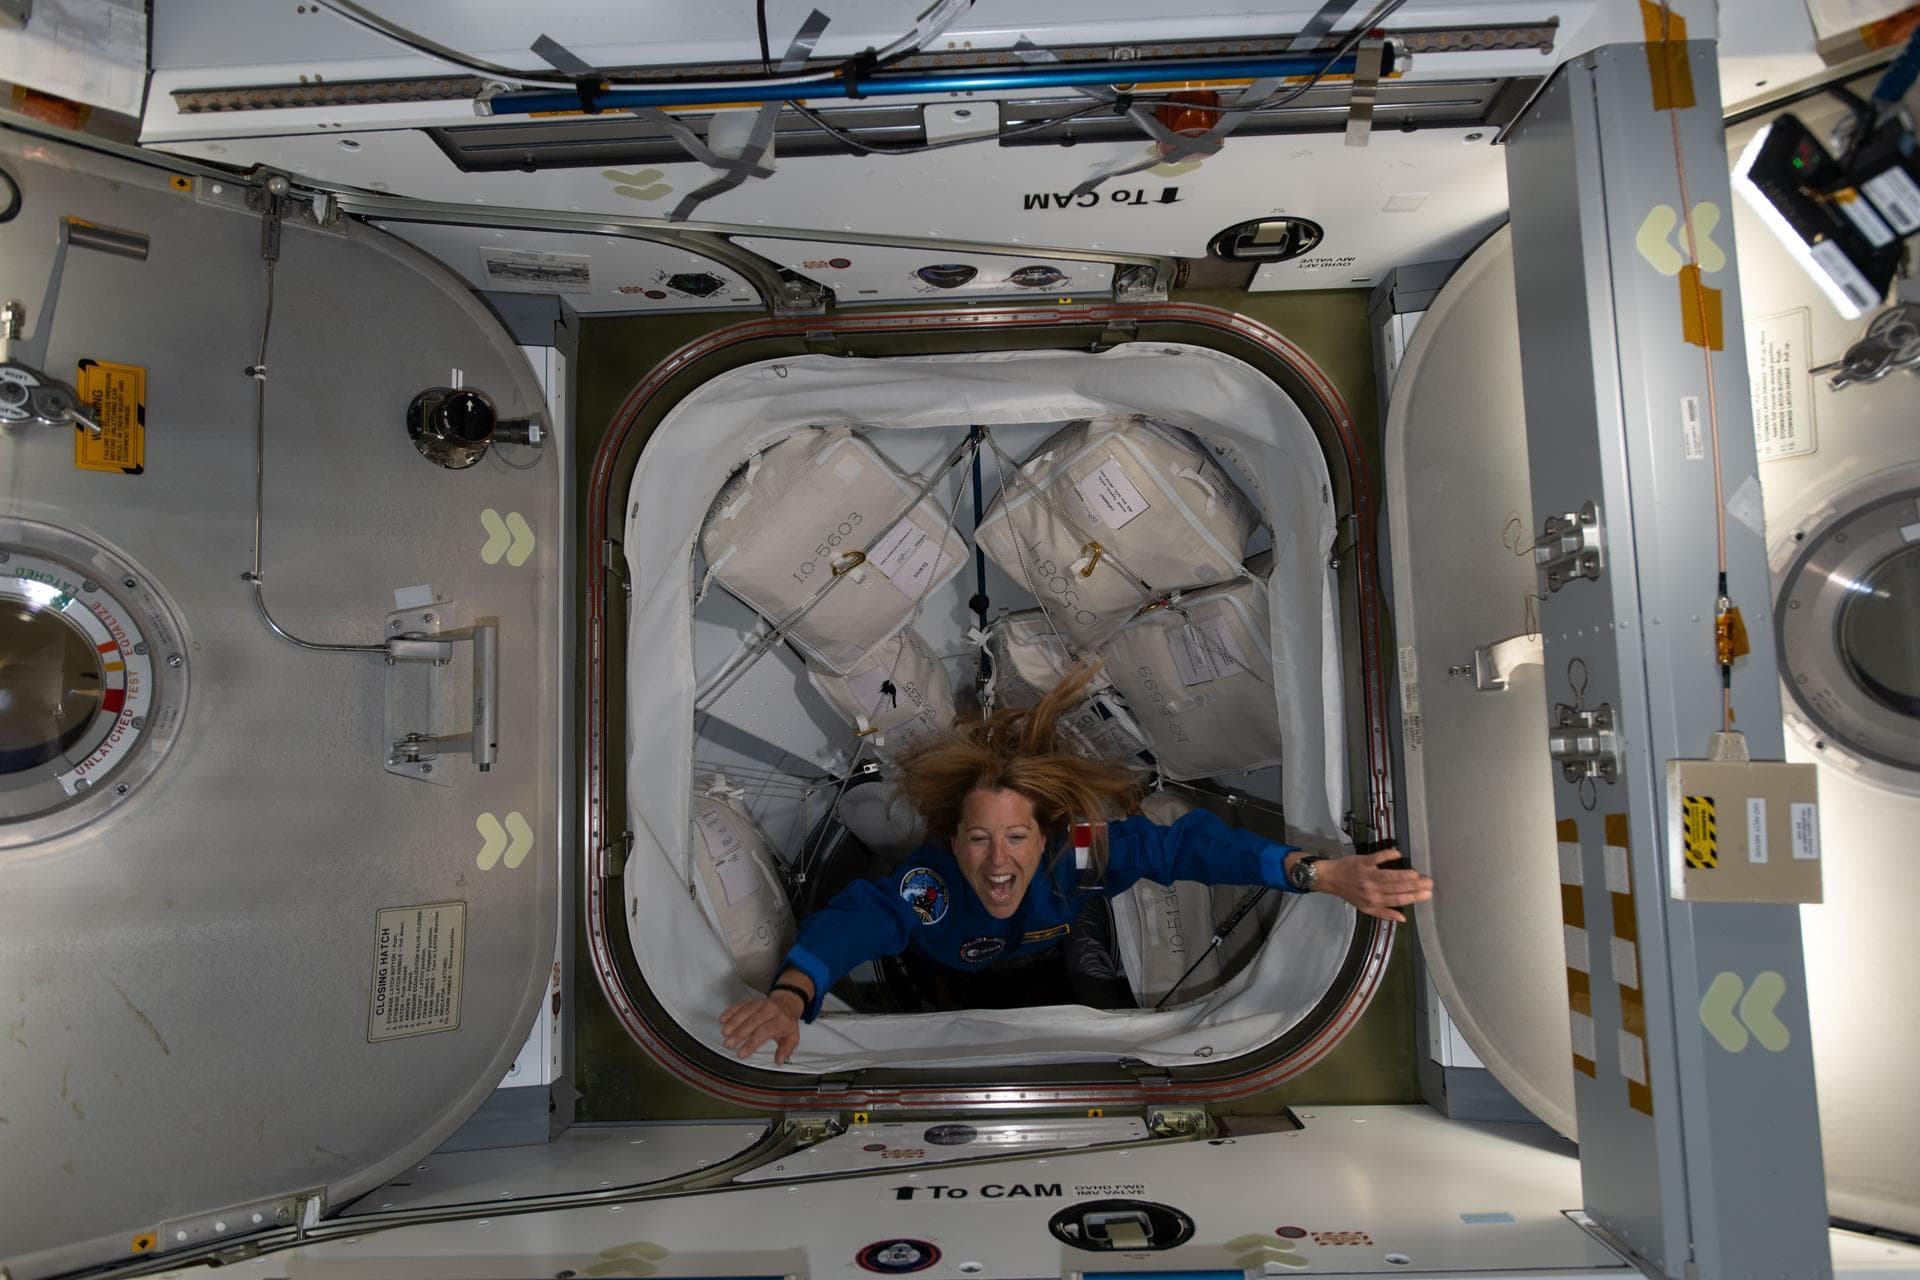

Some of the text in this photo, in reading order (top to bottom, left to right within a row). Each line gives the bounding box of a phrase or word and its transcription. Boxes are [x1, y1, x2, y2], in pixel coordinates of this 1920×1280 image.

[1023, 189, 1147, 209] To CAM
[15, 566, 81, 597] LATCHED
[90, 601, 133, 656] EQUALIZE
[127, 670, 139, 699] TEST
[74, 708, 134, 776] UNLATCHED
[1753, 802, 1759, 814] DO
[375, 927, 390, 1015] CLOSING HATCH
[926, 1183, 1063, 1199] To CAM
